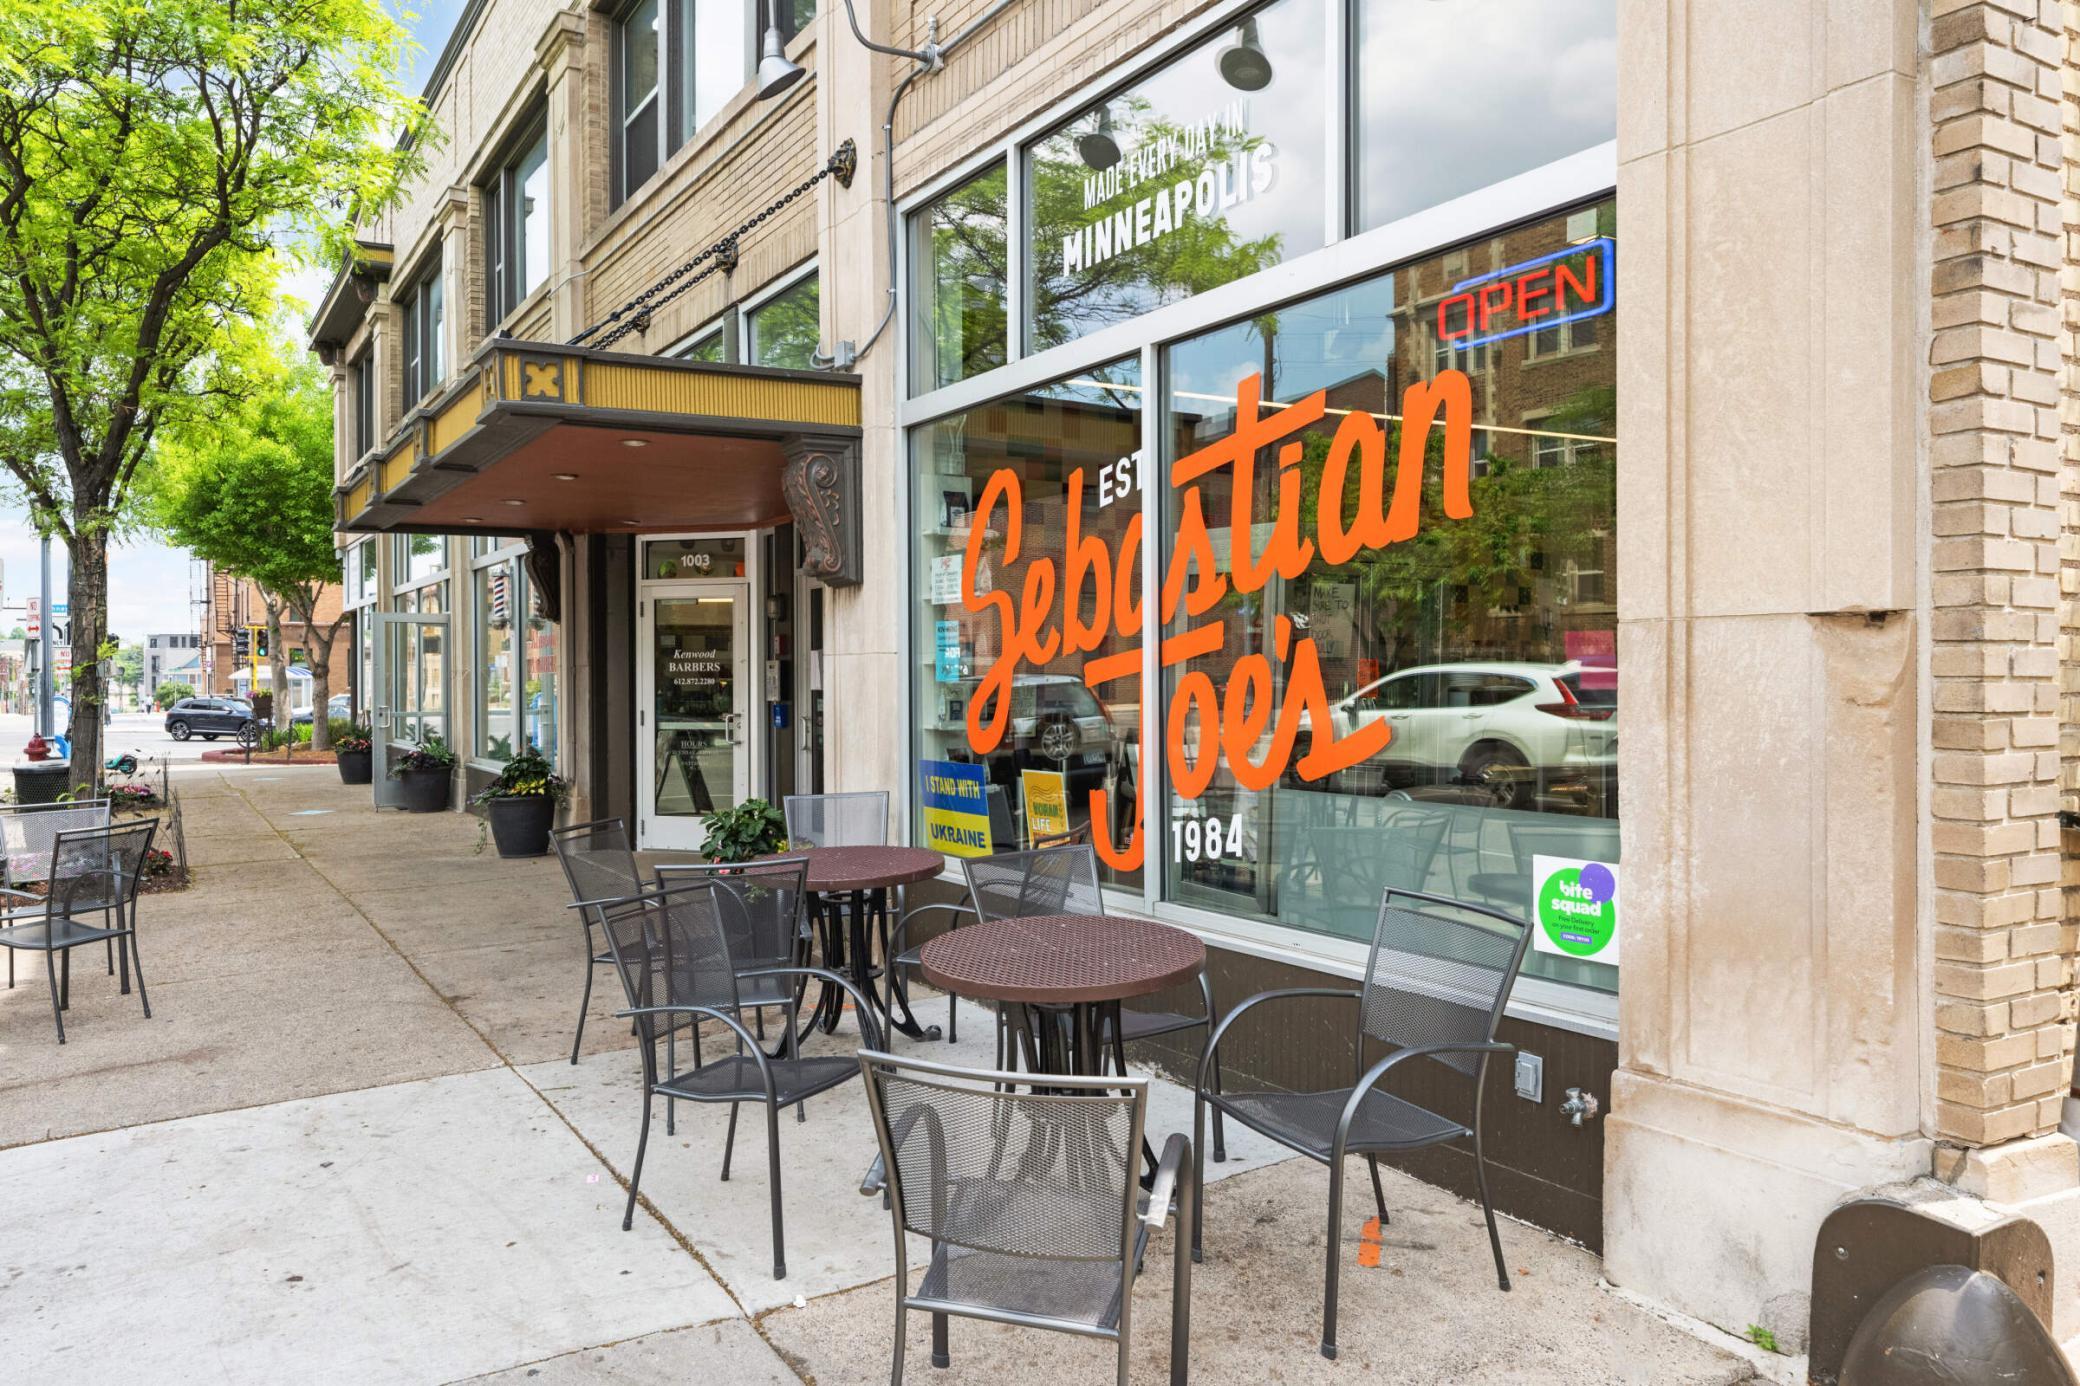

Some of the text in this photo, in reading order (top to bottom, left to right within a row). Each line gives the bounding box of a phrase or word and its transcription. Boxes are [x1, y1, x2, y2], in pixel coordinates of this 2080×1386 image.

[1084, 97, 1244, 211] MADE EVERY DAY IN
[1063, 143, 1273, 278] MINNEAPOLIS
[1437, 255, 1596, 341] OPEN
[681, 553, 711, 569] 1003
[961, 369, 1474, 755] Sebastian
[669, 661, 721, 673] BARBERS
[673, 649, 717, 660] Kenwood
[1084, 614, 1393, 873] Joe's
[925, 775, 981, 800] I STAND WITH
[930, 822, 987, 849] UKRAINE
[1031, 817, 1051, 832] LIFE
[1172, 813, 1243, 864] 1984
[1559, 879, 1594, 900] bite
[1551, 898, 1602, 918] squad
